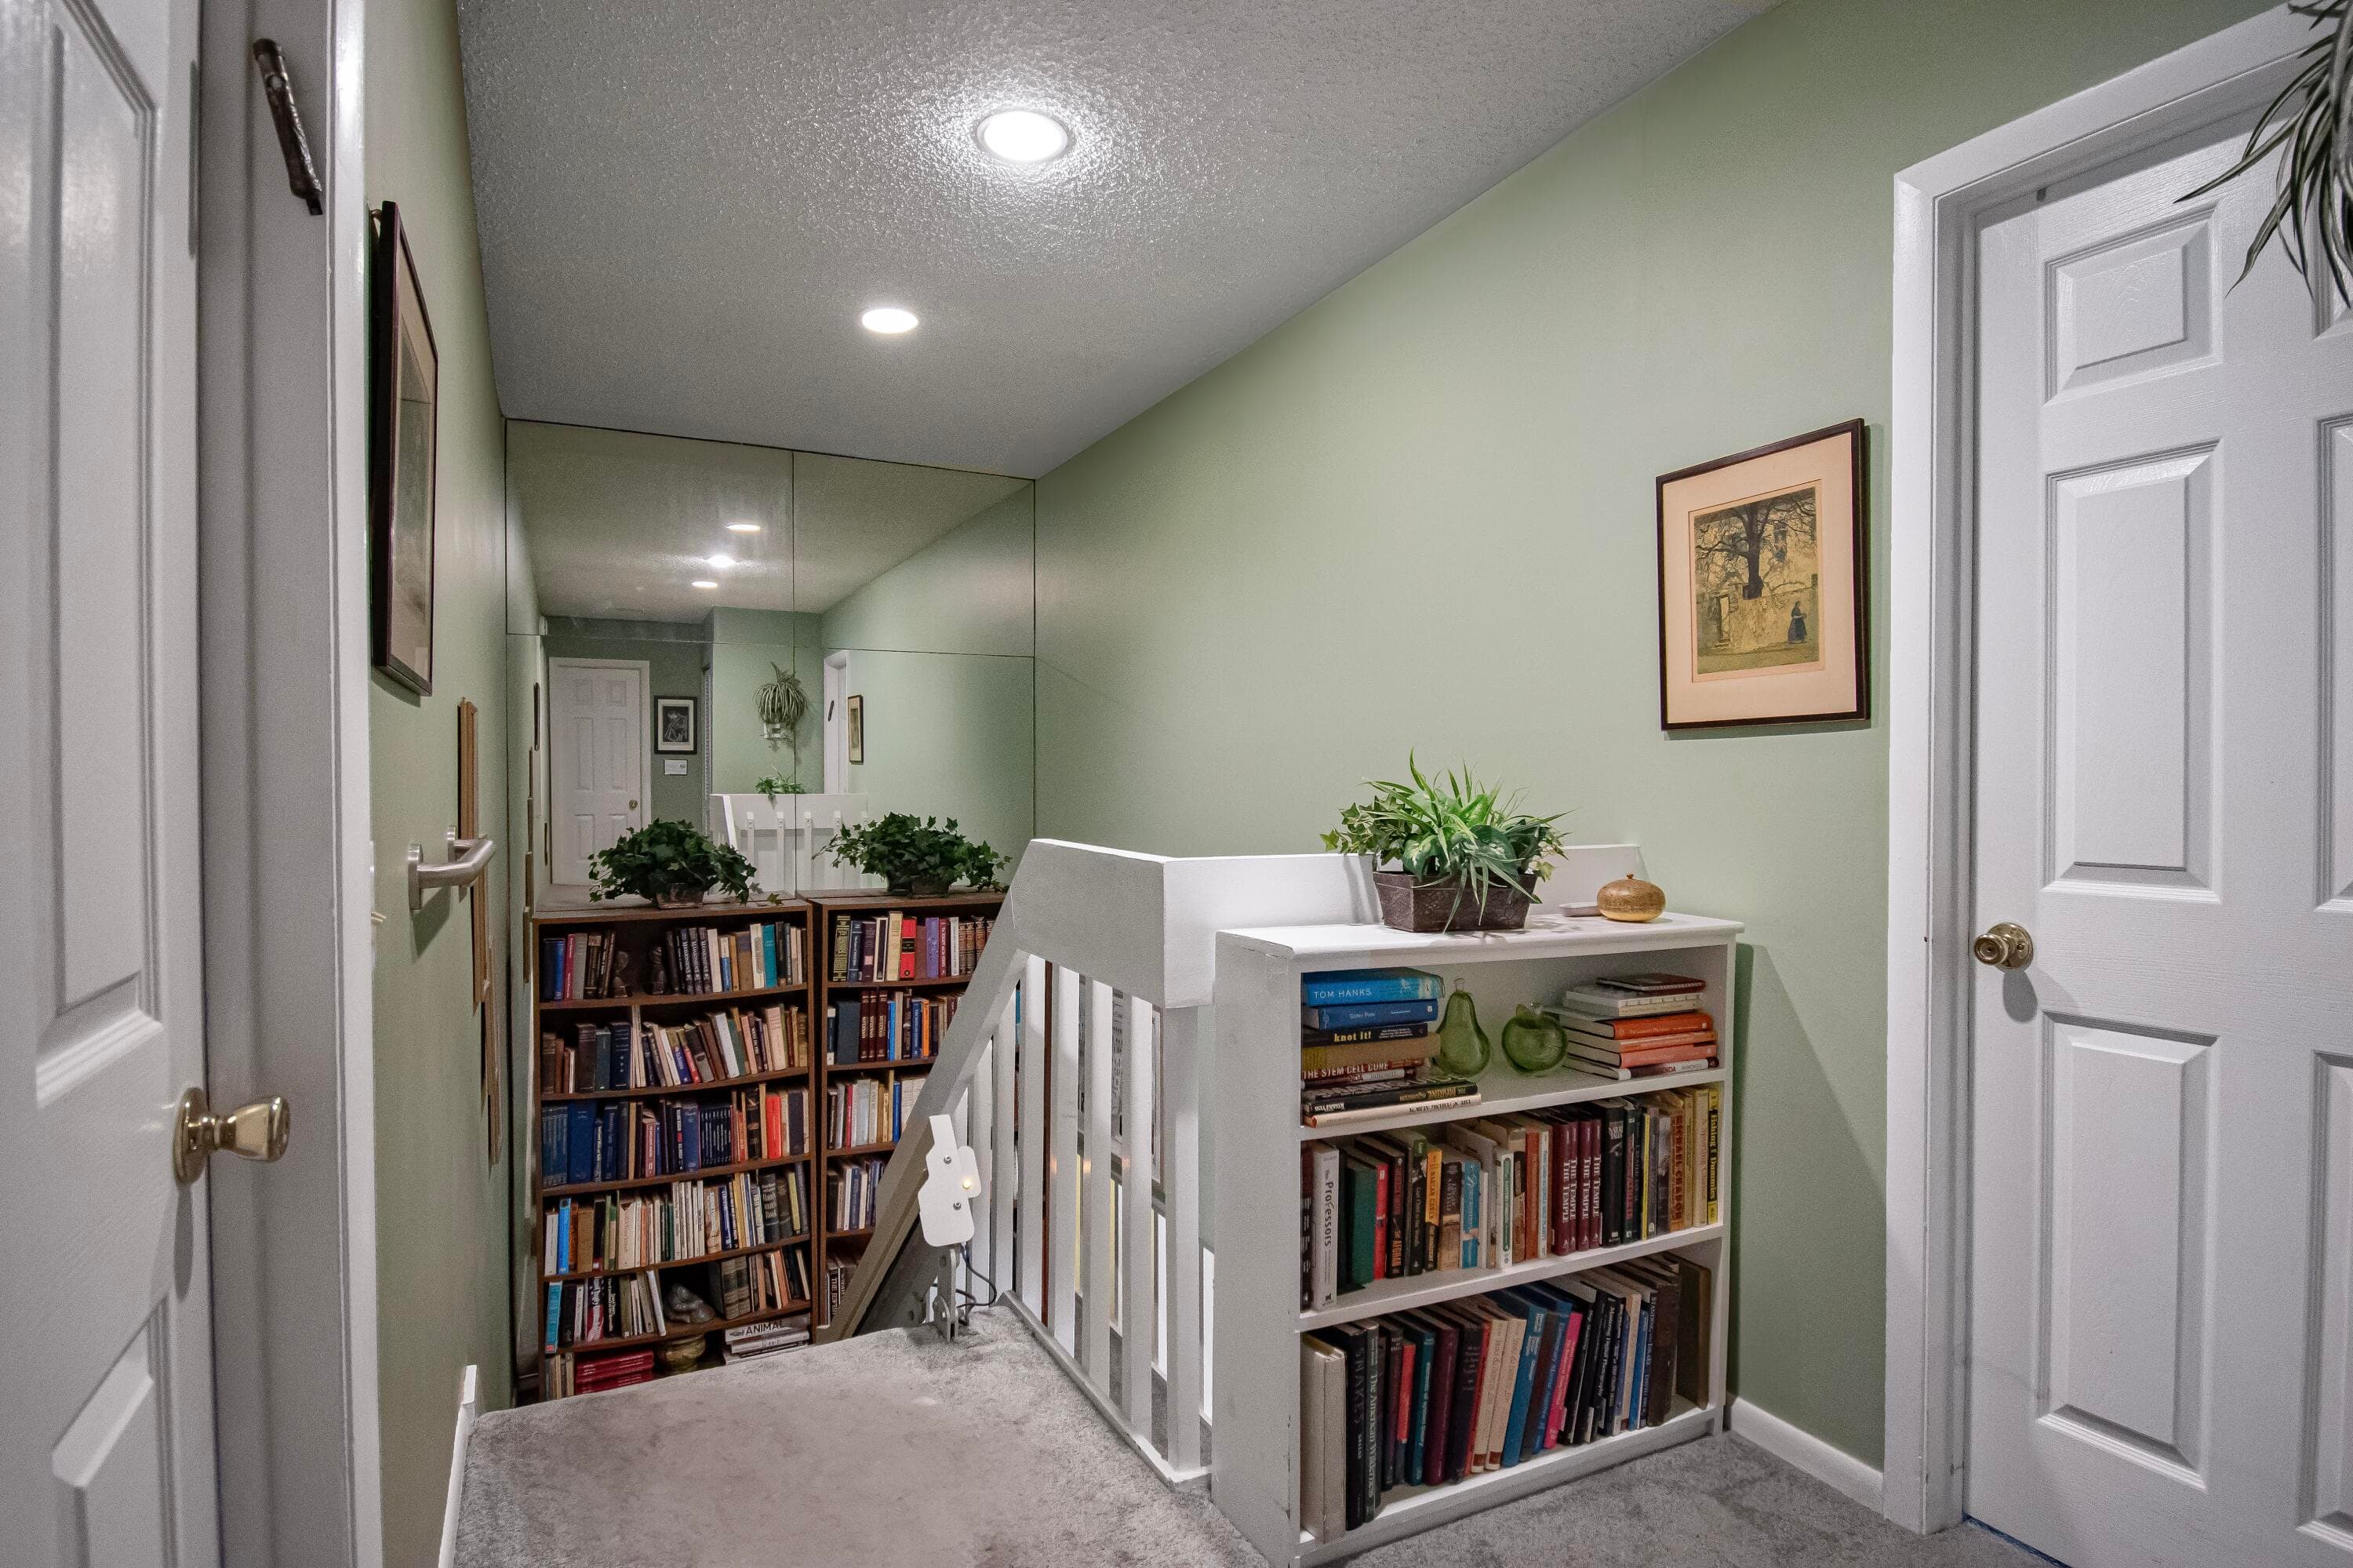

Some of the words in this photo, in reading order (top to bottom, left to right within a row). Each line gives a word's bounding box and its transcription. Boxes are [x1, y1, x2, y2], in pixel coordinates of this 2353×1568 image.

[1315, 990, 1334, 999] TOM
[1339, 988, 1373, 997] HANKS
[1334, 1032, 1356, 1042] knot
[1360, 1031, 1372, 1040] it!
[1303, 1070, 1318, 1079] THE
[1321, 1068, 1345, 1078] STEM
[1347, 1065, 1366, 1074] CELL
[1582, 1181, 1591, 1220] TEMPLE
[1675, 1170, 1683, 1220] CHABON
[1324, 1182, 1334, 1246] Professors
[1392, 1240, 1402, 1267] AFGHAN
[1606, 1307, 1615, 1336] Mastering
[1354, 1347, 1366, 1424] SNAKES
[1597, 1359, 1609, 1396] Photography
